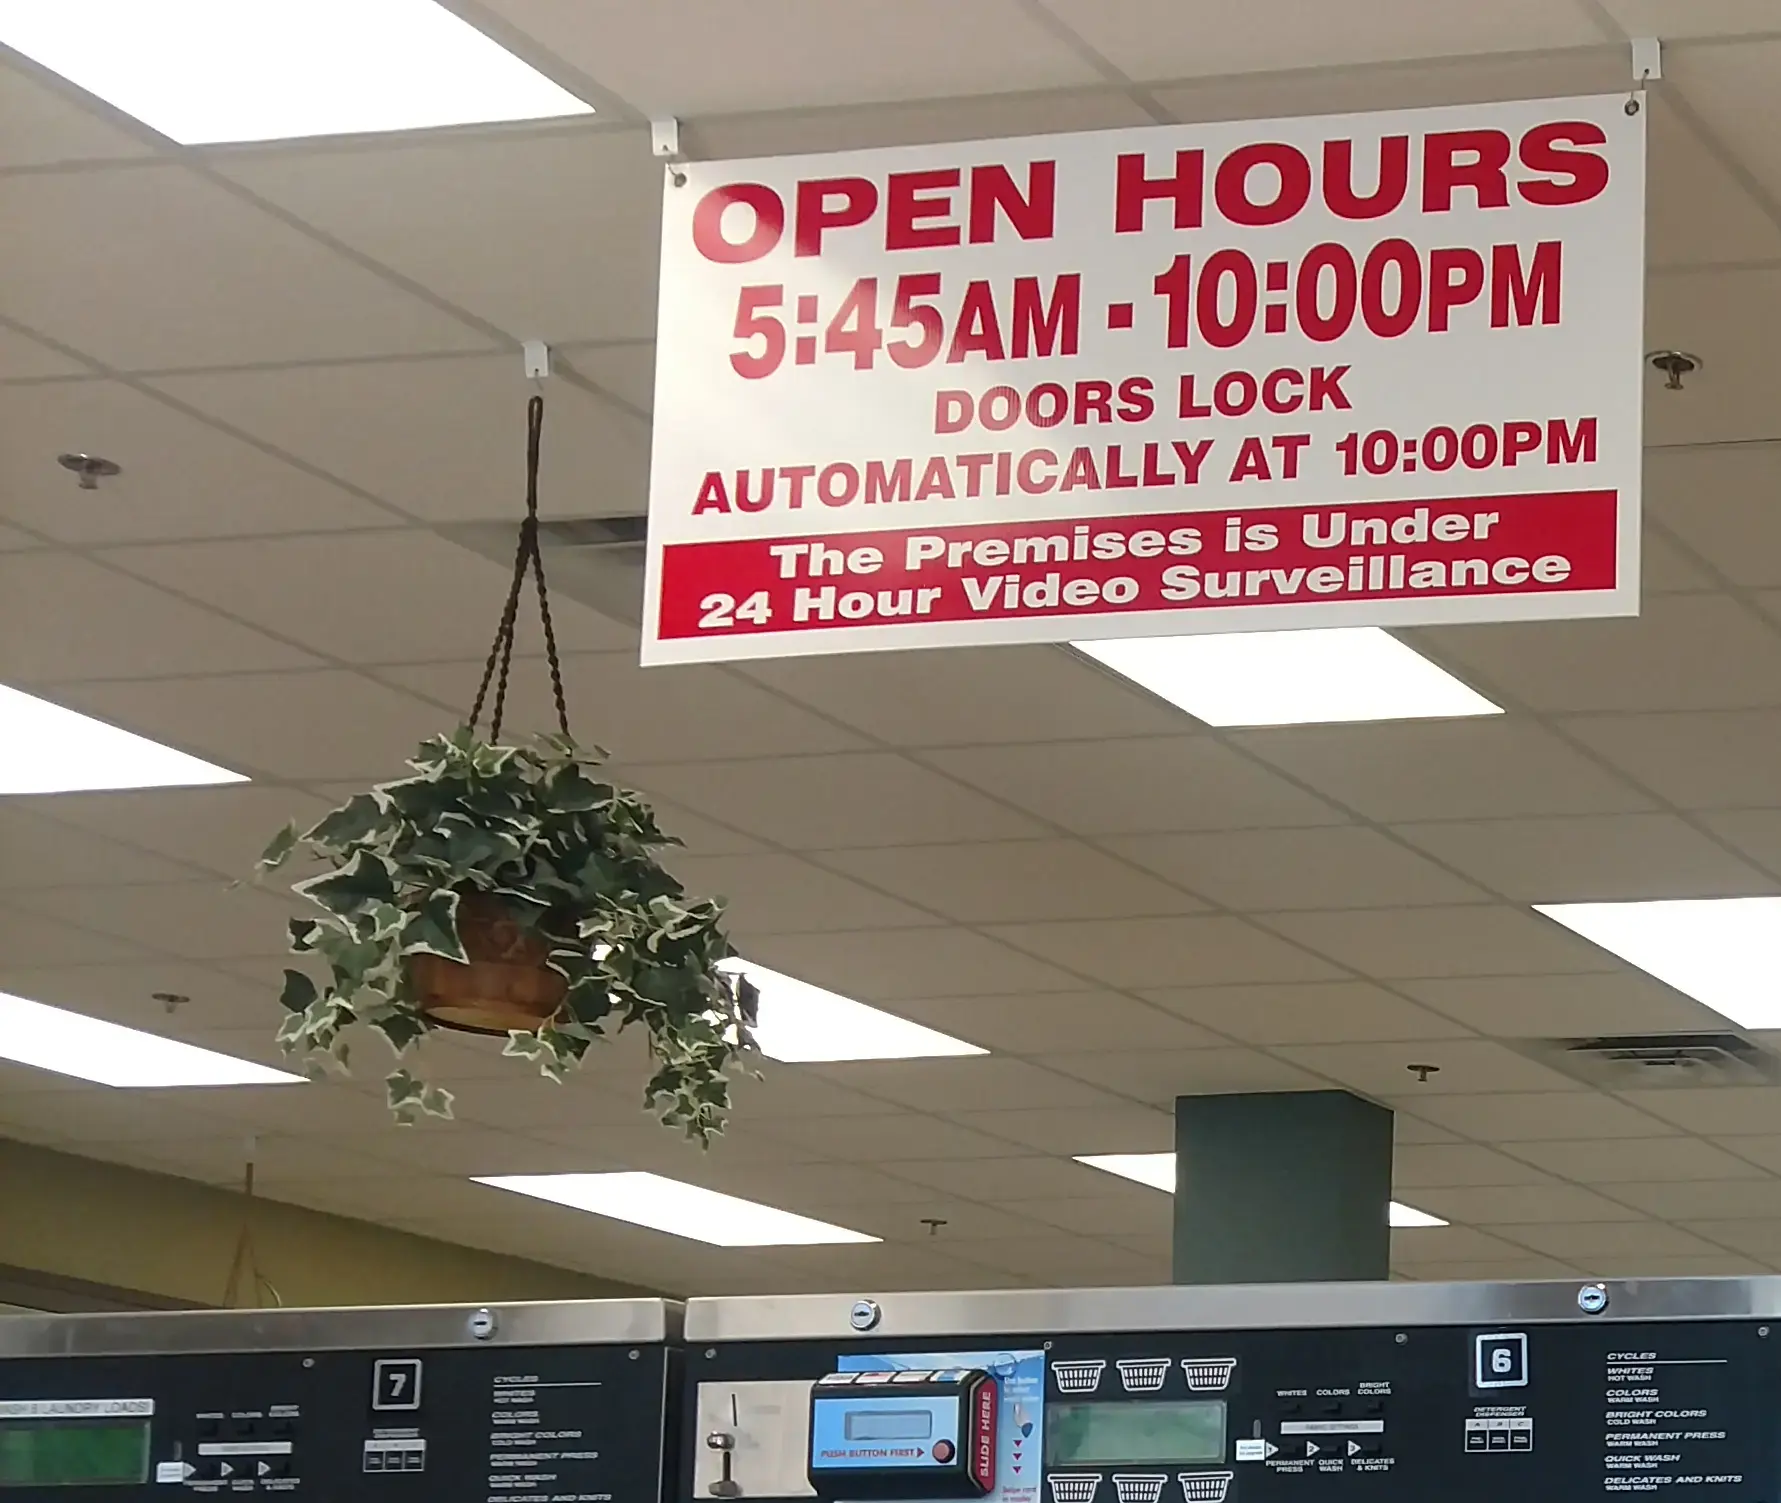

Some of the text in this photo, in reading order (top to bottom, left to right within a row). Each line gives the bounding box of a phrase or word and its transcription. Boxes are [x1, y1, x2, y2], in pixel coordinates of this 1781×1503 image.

[691, 120, 1609, 264] OPEN HOURS
[729, 271, 1079, 378] 5:45AM
[1153, 239, 1562, 350] 10:00PM
[933, 365, 1352, 435] DOORS LOCK
[691, 417, 1598, 515] AUTOMATICALLY AT 10:00PM
[770, 507, 1499, 581] The Premises is Under
[699, 548, 1571, 629] 24 Hour Video Surveillance
[1492, 1349, 1511, 1372] 6
[1607, 1352, 1656, 1360] CYCLES
[388, 1373, 406, 1397] 7
[981, 1392, 991, 1431] HERE
[821, 1450, 846, 1458] PUSH
[850, 1449, 888, 1457] BUTTON
[1605, 1432, 1682, 1440] PERMANENT
[981, 1436, 990, 1477] SLIDE
[1706, 1475, 1742, 1483] KNITS
